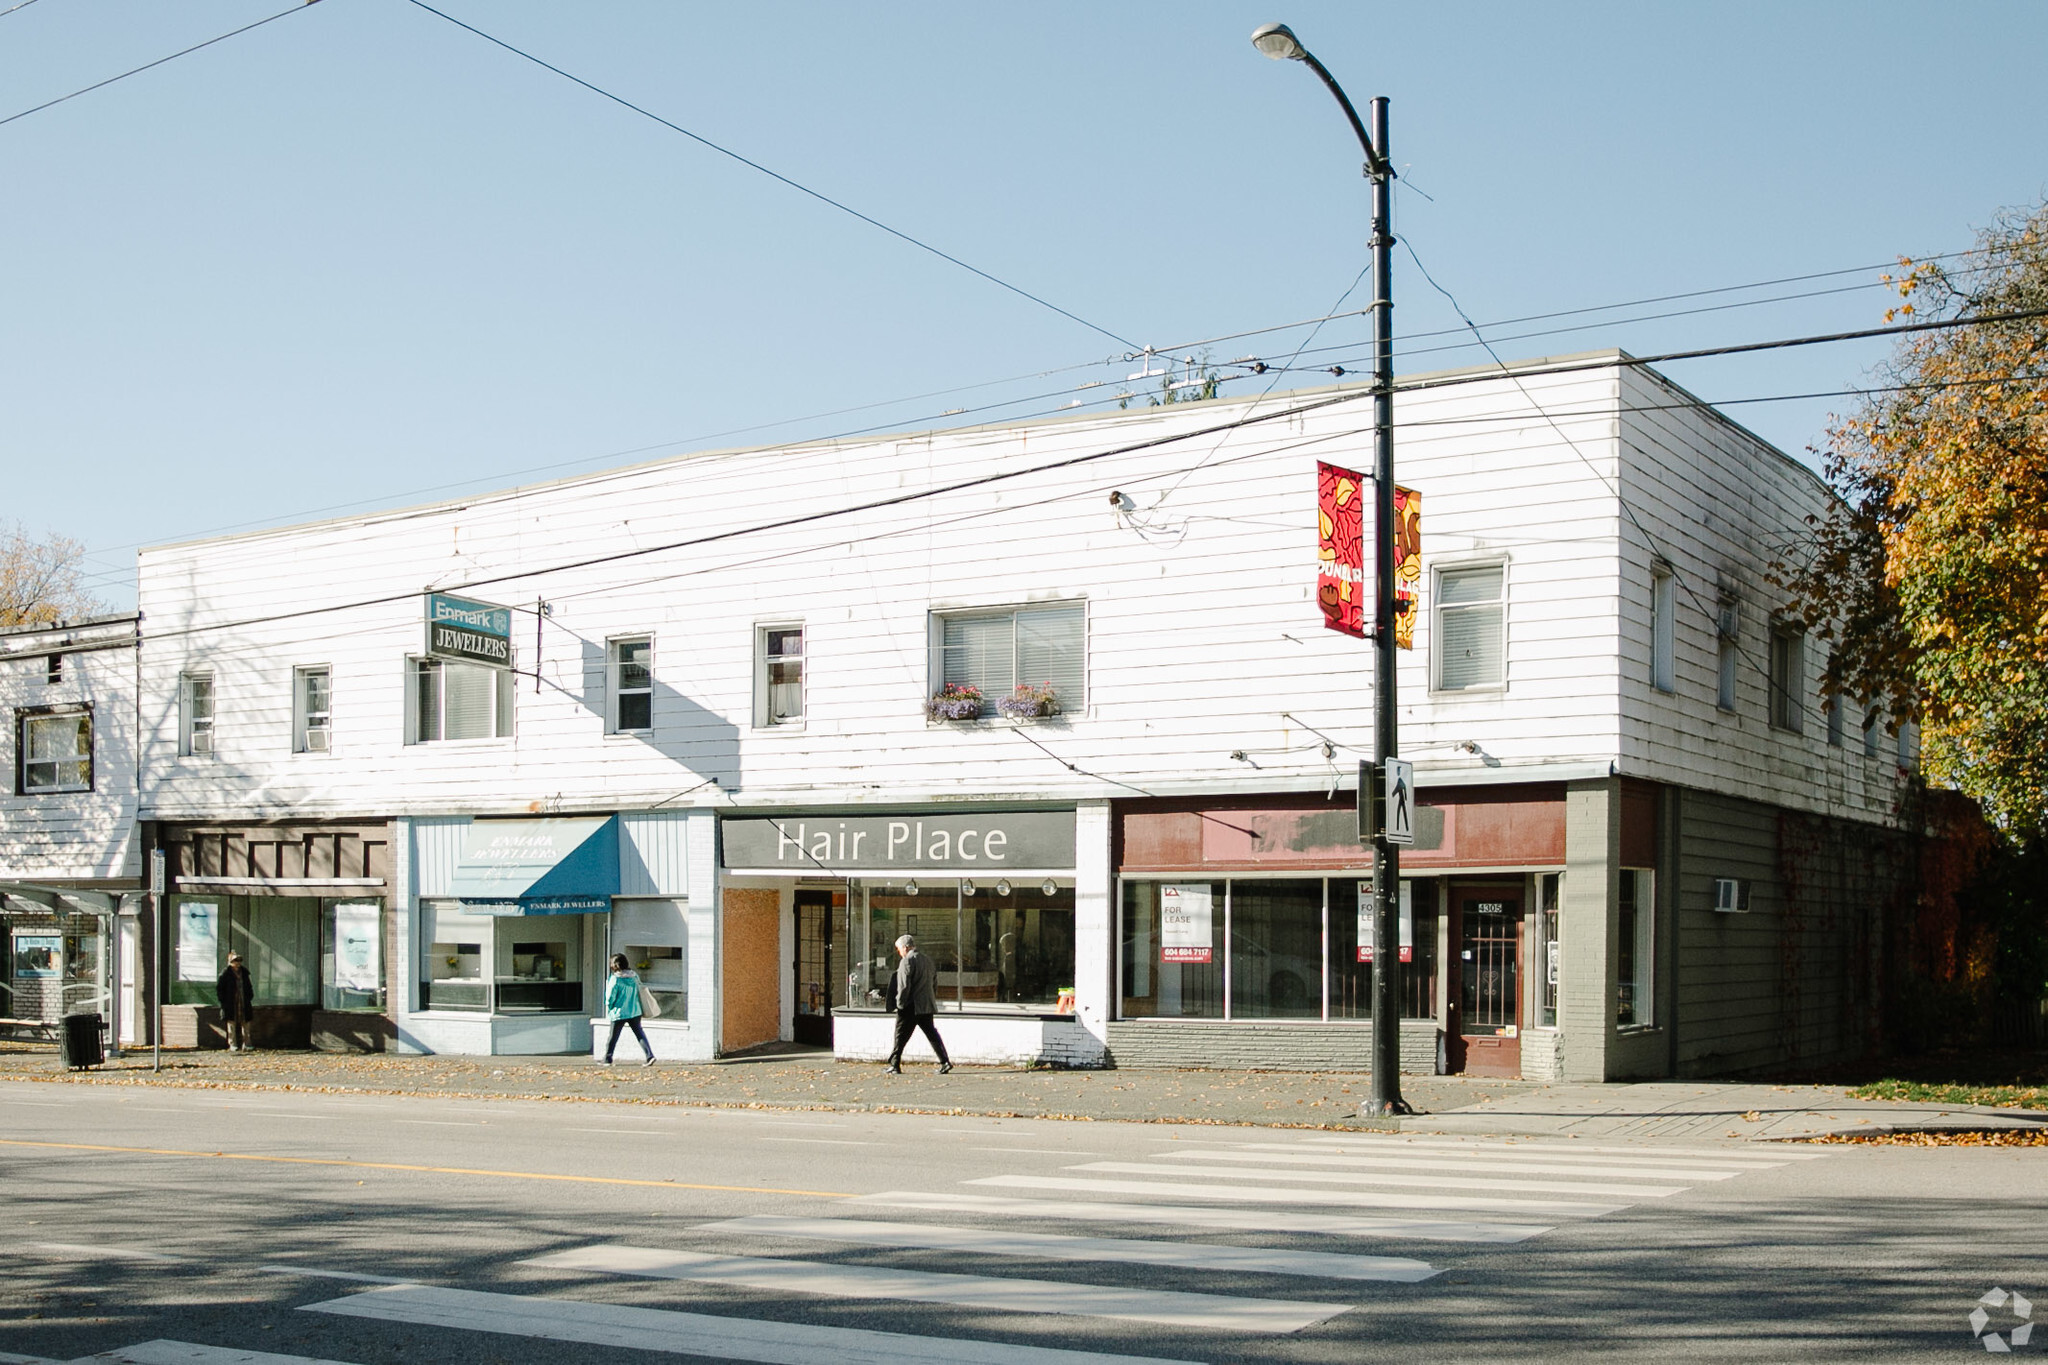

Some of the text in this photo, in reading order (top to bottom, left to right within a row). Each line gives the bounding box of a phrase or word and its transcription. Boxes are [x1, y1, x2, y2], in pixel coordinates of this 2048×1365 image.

[436, 602, 490, 627] Enmark
[437, 629, 507, 658] JEWELLERS
[492, 836, 552, 846] ENMARK
[778, 821, 1007, 860] Hair Place
[472, 849, 556, 859] JEWELLERS
[1479, 904, 1502, 912] 4305
